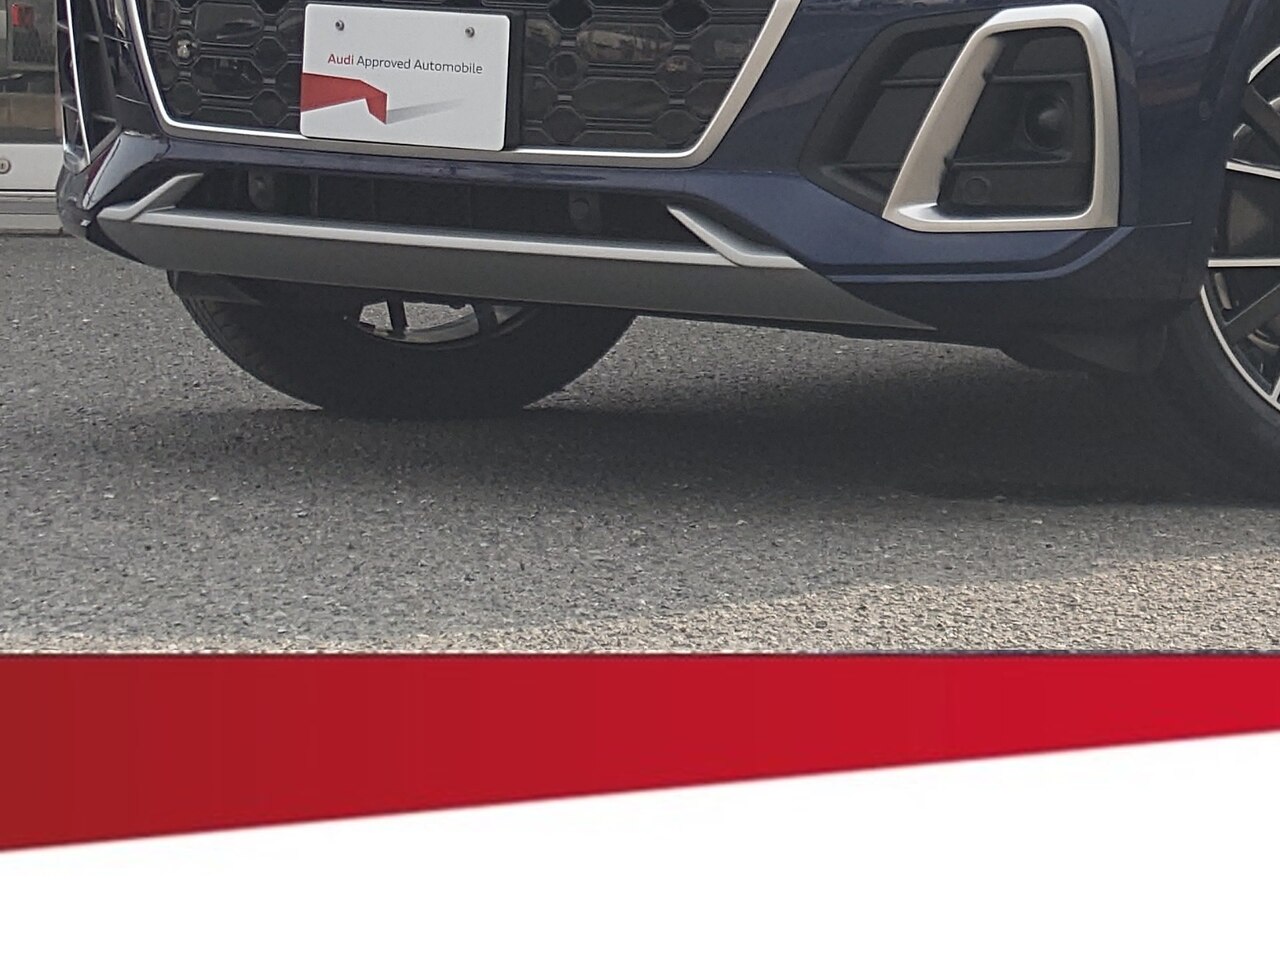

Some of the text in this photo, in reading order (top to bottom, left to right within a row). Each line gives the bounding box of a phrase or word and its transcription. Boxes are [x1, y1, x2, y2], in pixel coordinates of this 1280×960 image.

[327, 53, 483, 74] Audi Approved Automobile
